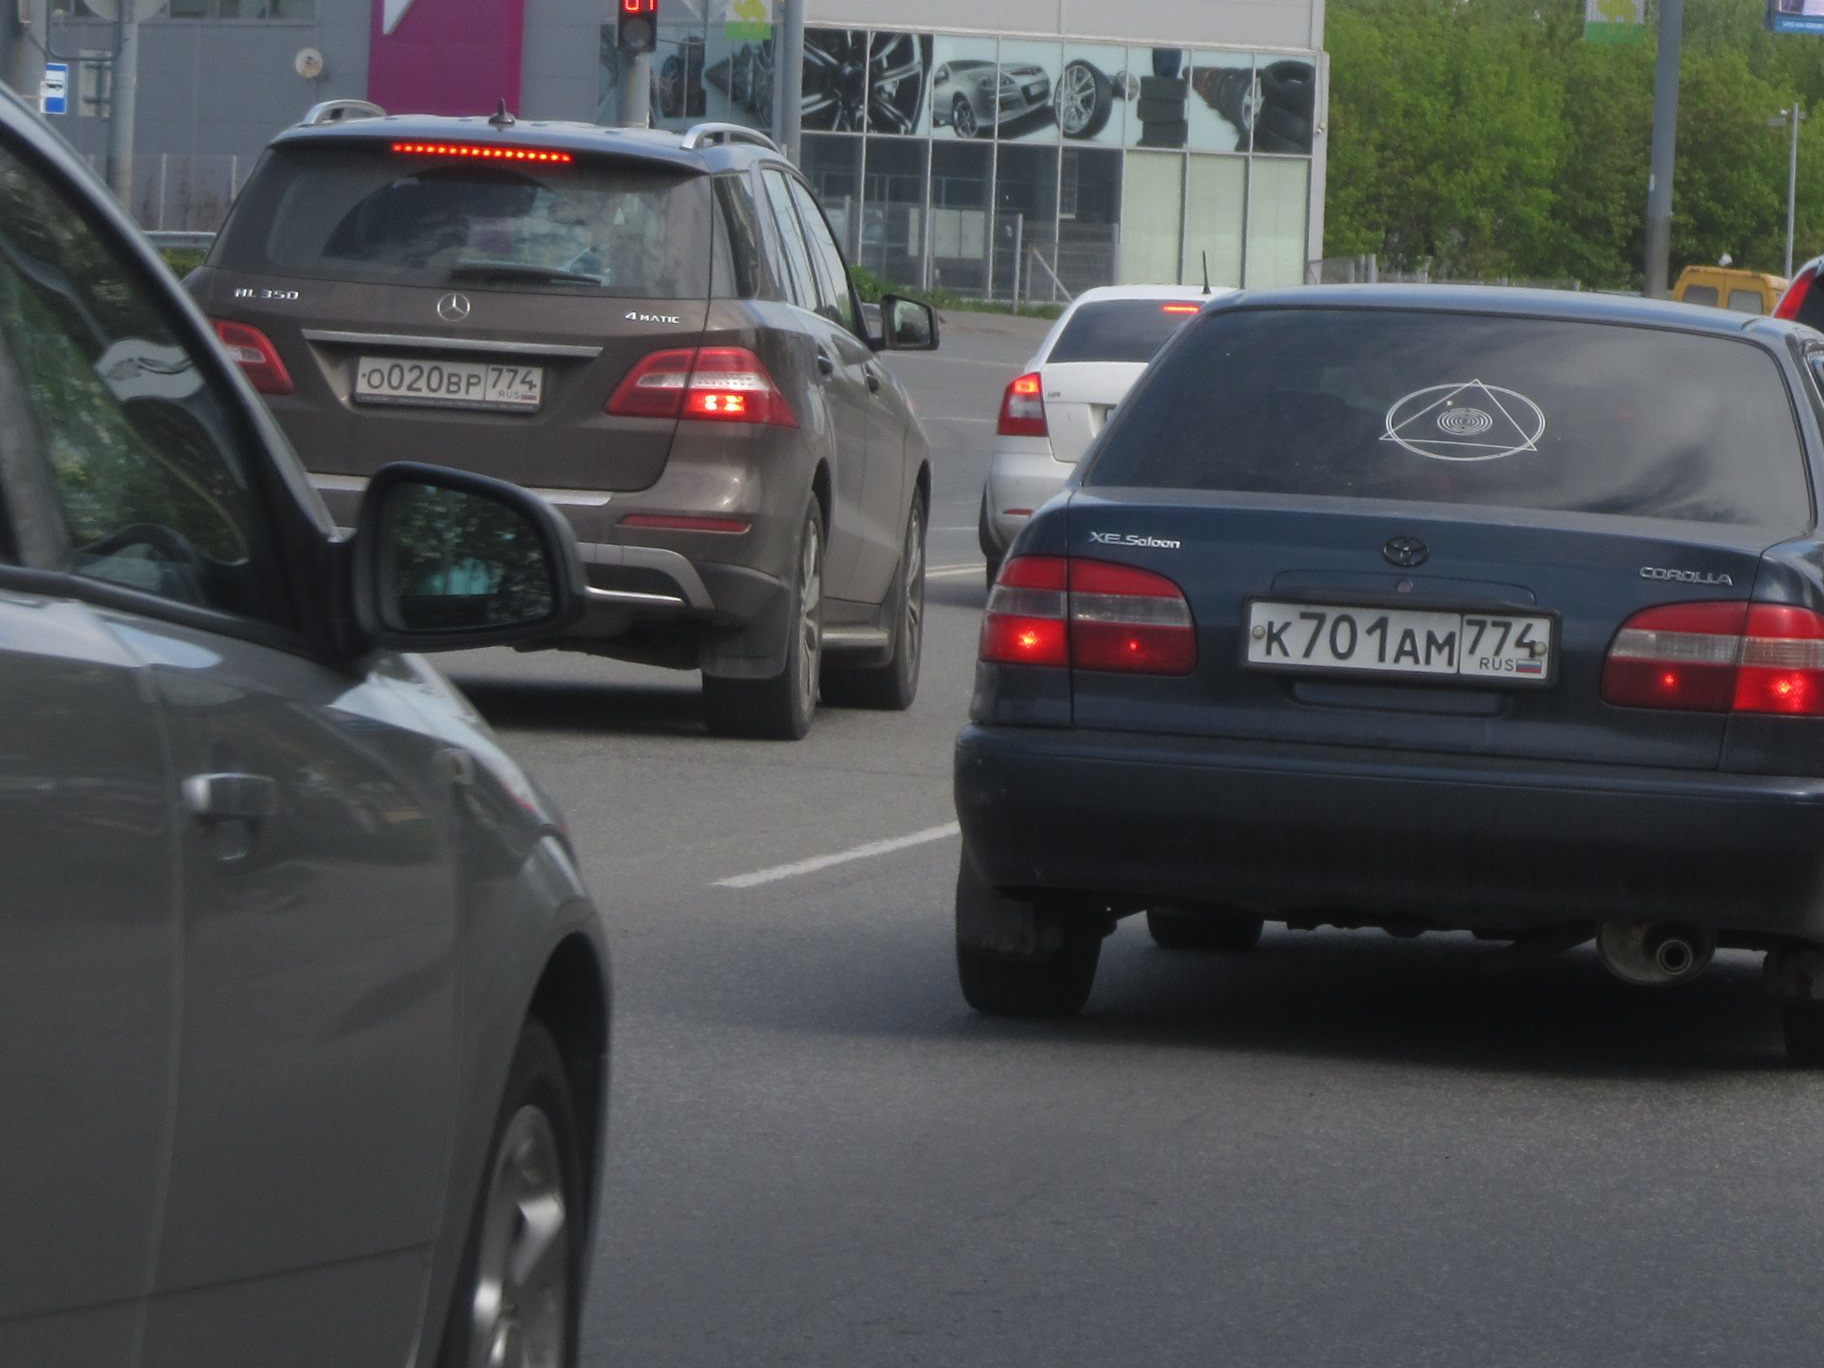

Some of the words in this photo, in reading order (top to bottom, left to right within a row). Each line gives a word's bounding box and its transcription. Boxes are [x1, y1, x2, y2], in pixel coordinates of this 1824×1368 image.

[259, 289, 299, 300] 350
[1640, 567, 1733, 586] COROLLA
[1479, 657, 1514, 671] RUS
